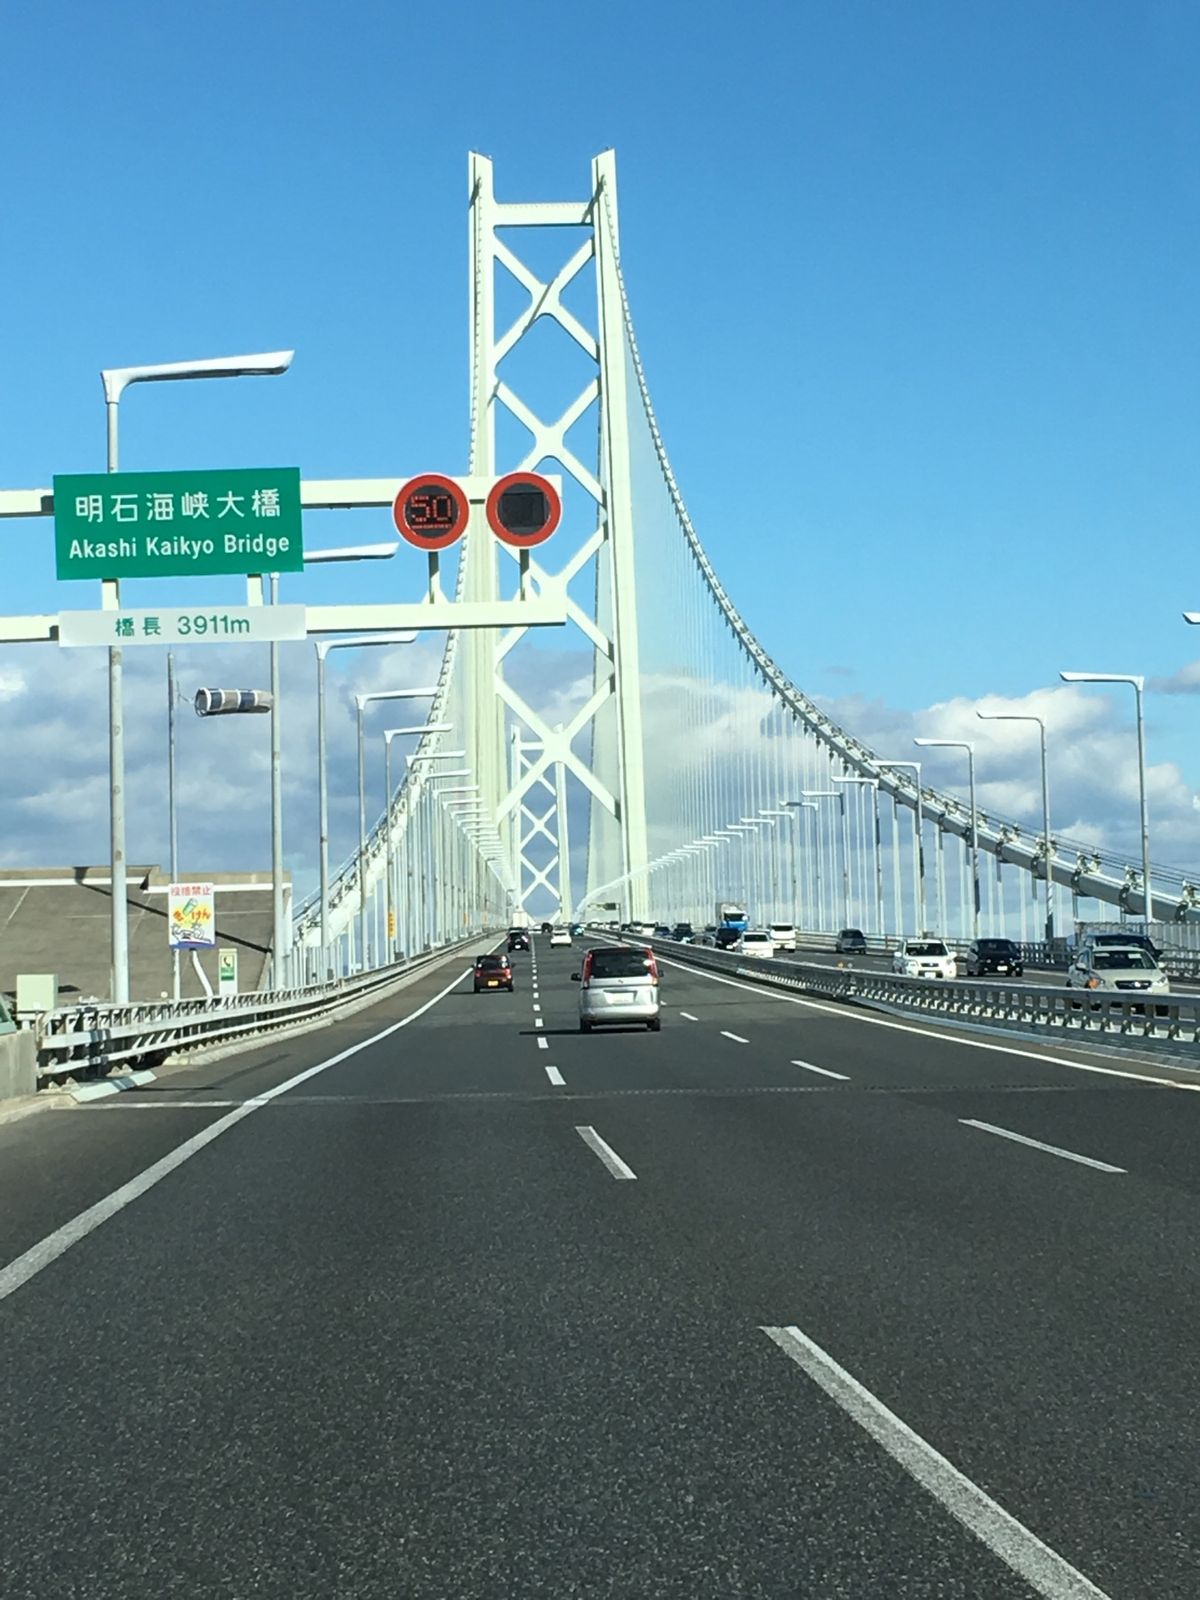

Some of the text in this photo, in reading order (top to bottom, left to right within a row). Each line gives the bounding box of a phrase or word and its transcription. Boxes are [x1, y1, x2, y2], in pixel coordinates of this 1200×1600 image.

[75, 488, 281, 523] 明石海峡大橋
[410, 495, 452, 522] 50
[69, 533, 290, 560] Akashi Kaikyo Bridge
[115, 615, 250, 637] 橋長 3911m
